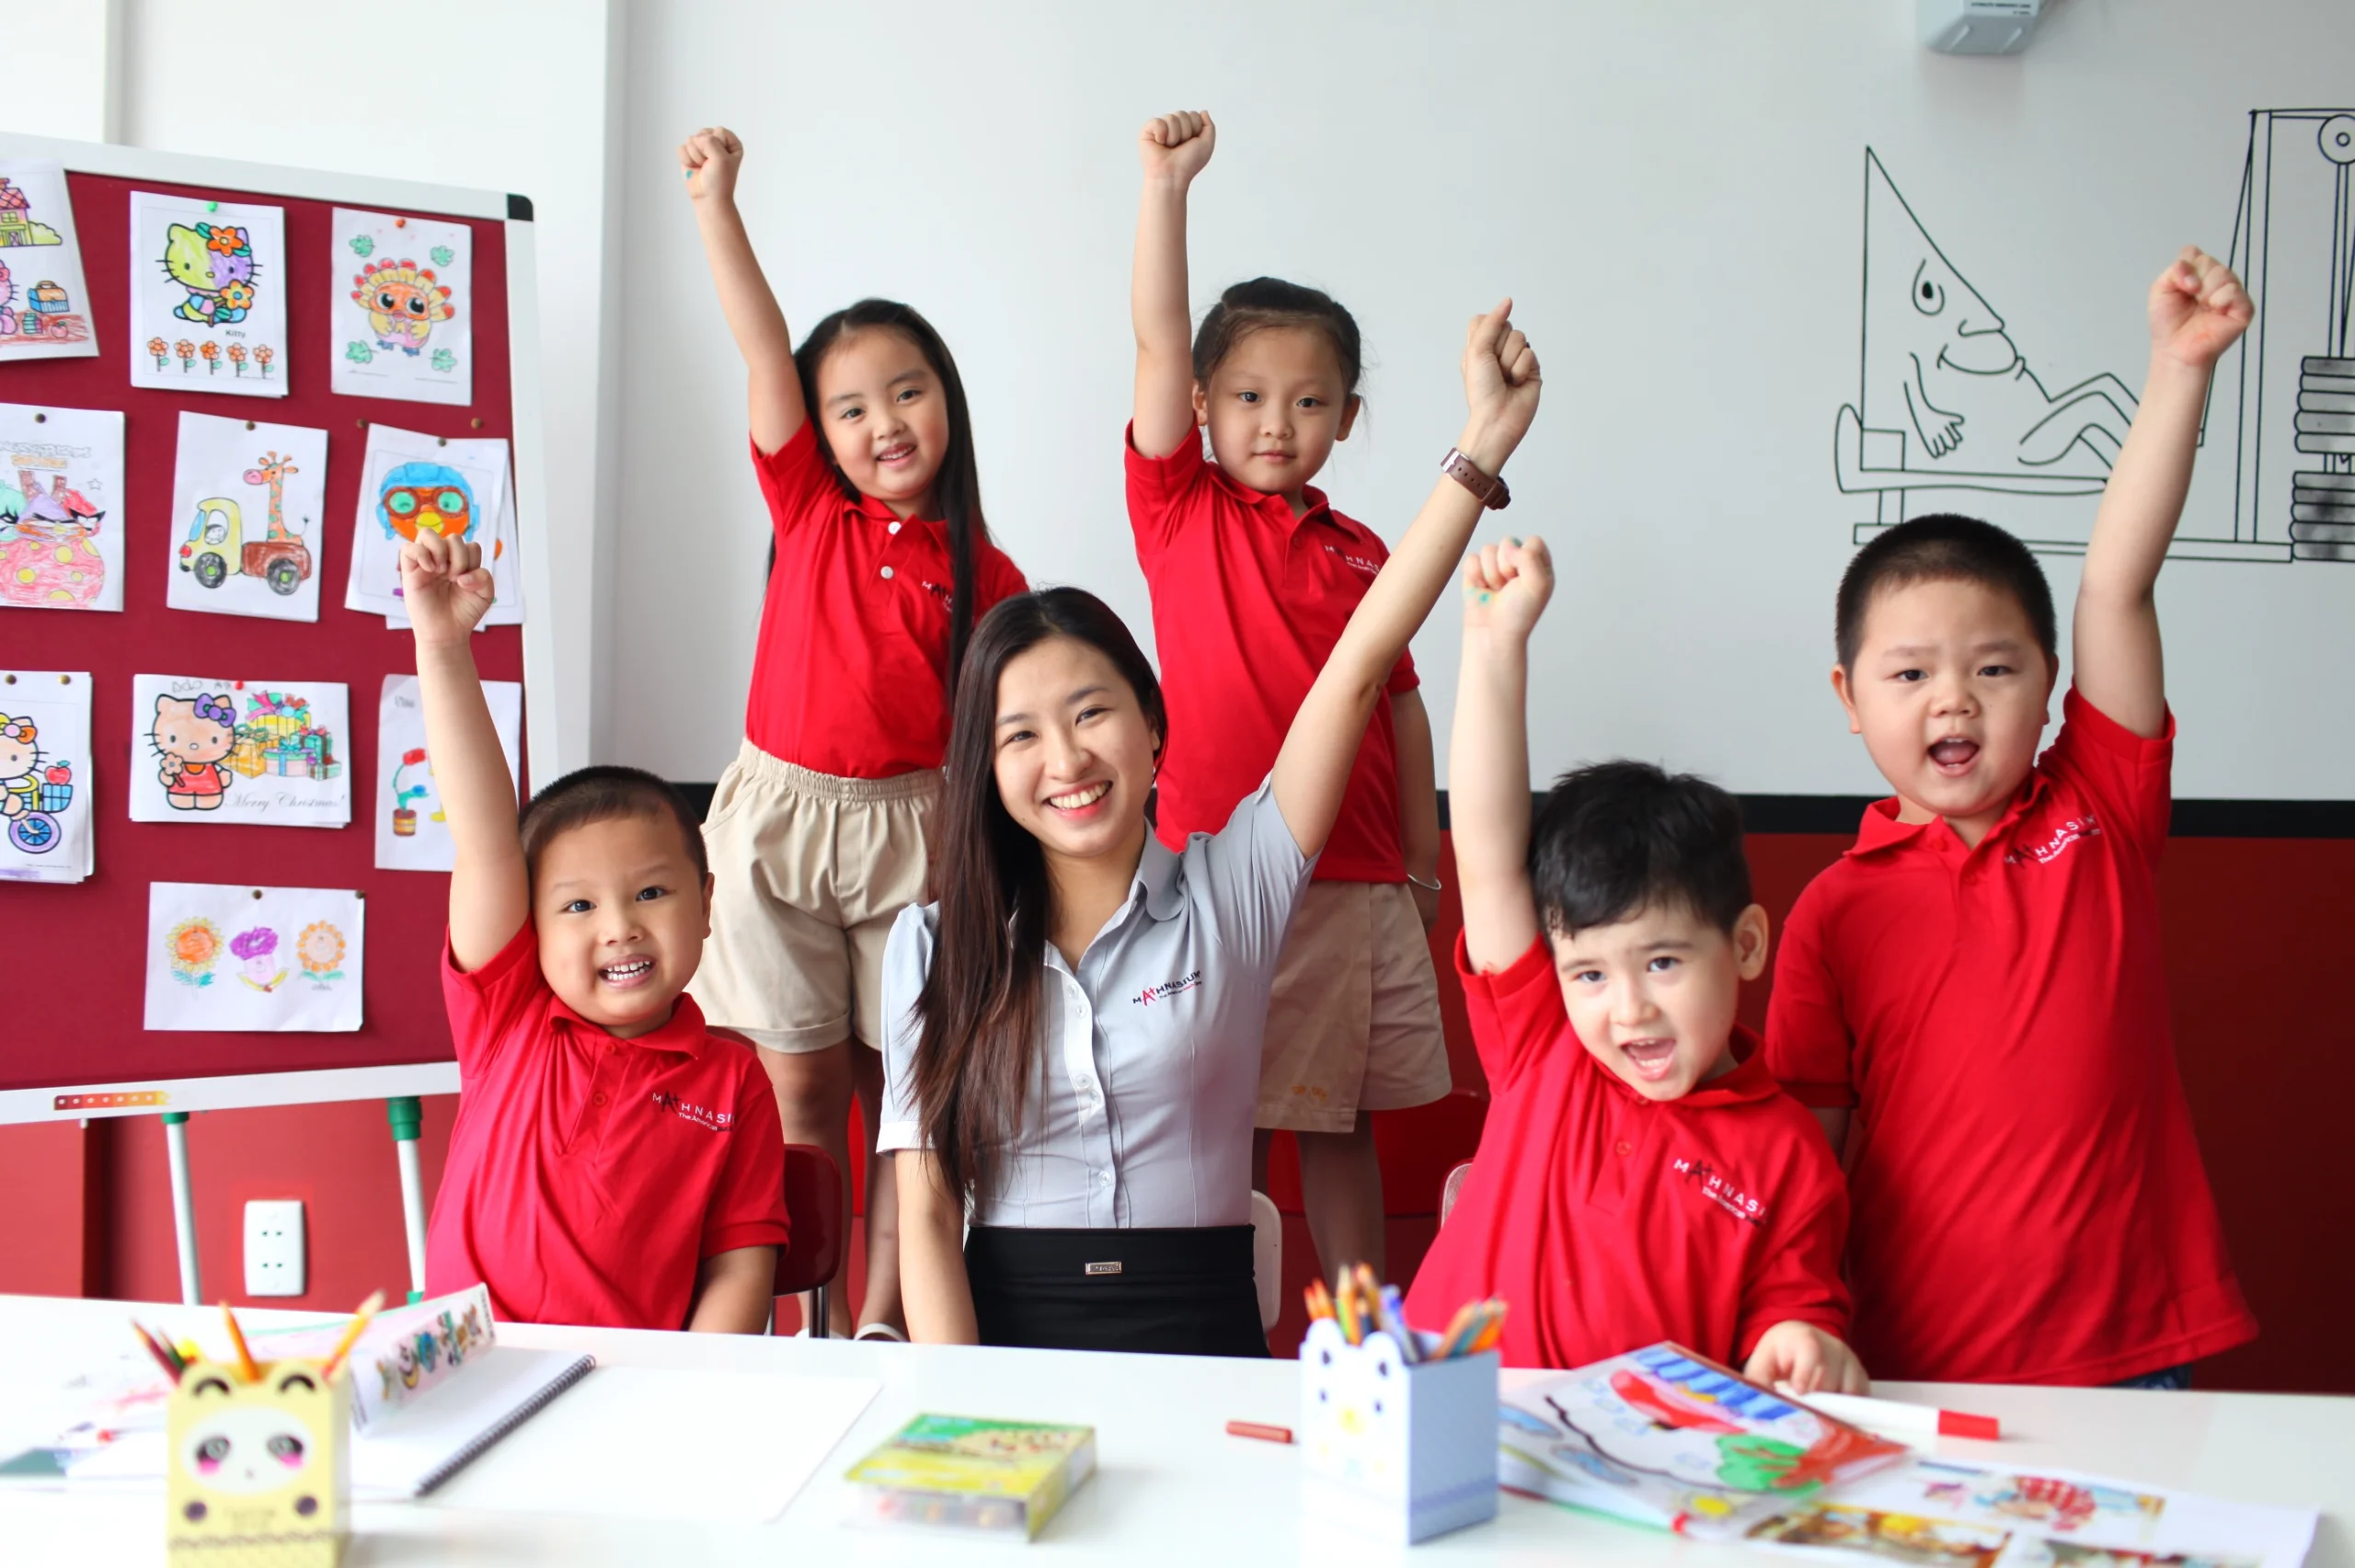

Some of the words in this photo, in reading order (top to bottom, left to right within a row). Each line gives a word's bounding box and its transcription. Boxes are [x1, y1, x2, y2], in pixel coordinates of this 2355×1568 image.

[224, 329, 247, 338] Kitty
[224, 791, 270, 813] Merry
[1132, 969, 1201, 1006] MATHNASIUM
